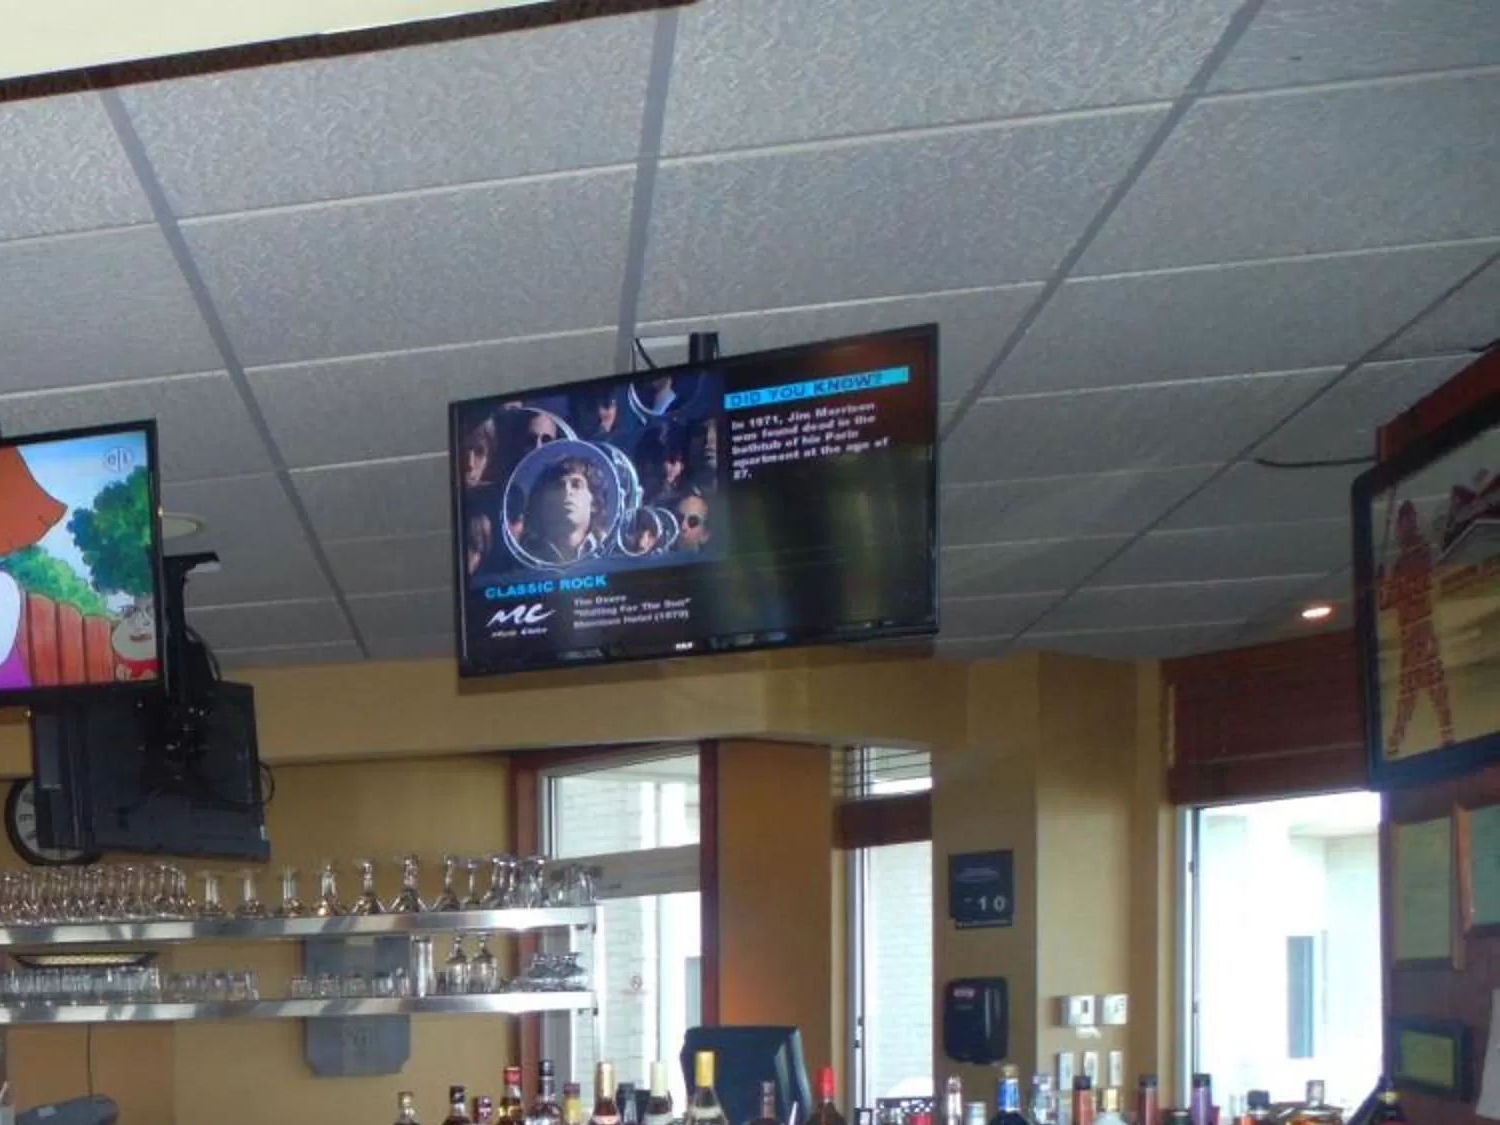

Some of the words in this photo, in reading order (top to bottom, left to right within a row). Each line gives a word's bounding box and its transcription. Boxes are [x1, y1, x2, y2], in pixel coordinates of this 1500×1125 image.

[731, 391, 761, 407] DID
[771, 386, 805, 400] YOU
[813, 373, 882, 396] KNOW?
[731, 419, 745, 431] In
[788, 410, 811, 422] Jim
[815, 402, 876, 418] Morrison
[731, 433, 758, 443] was
[761, 423, 799, 437] found
[802, 421, 835, 433] dead
[854, 413, 877, 425] the
[731, 440, 782, 456] bathtub
[785, 437, 799, 448] of
[801, 434, 821, 445] his
[825, 429, 860, 442] Paris
[732, 451, 800, 468] apartment
[803, 448, 818, 458] at
[820, 444, 842, 456] the
[845, 441, 870, 455] age
[874, 435, 891, 447] of
[484, 580, 554, 599] CLASSIC
[559, 574, 607, 591] ROCK
